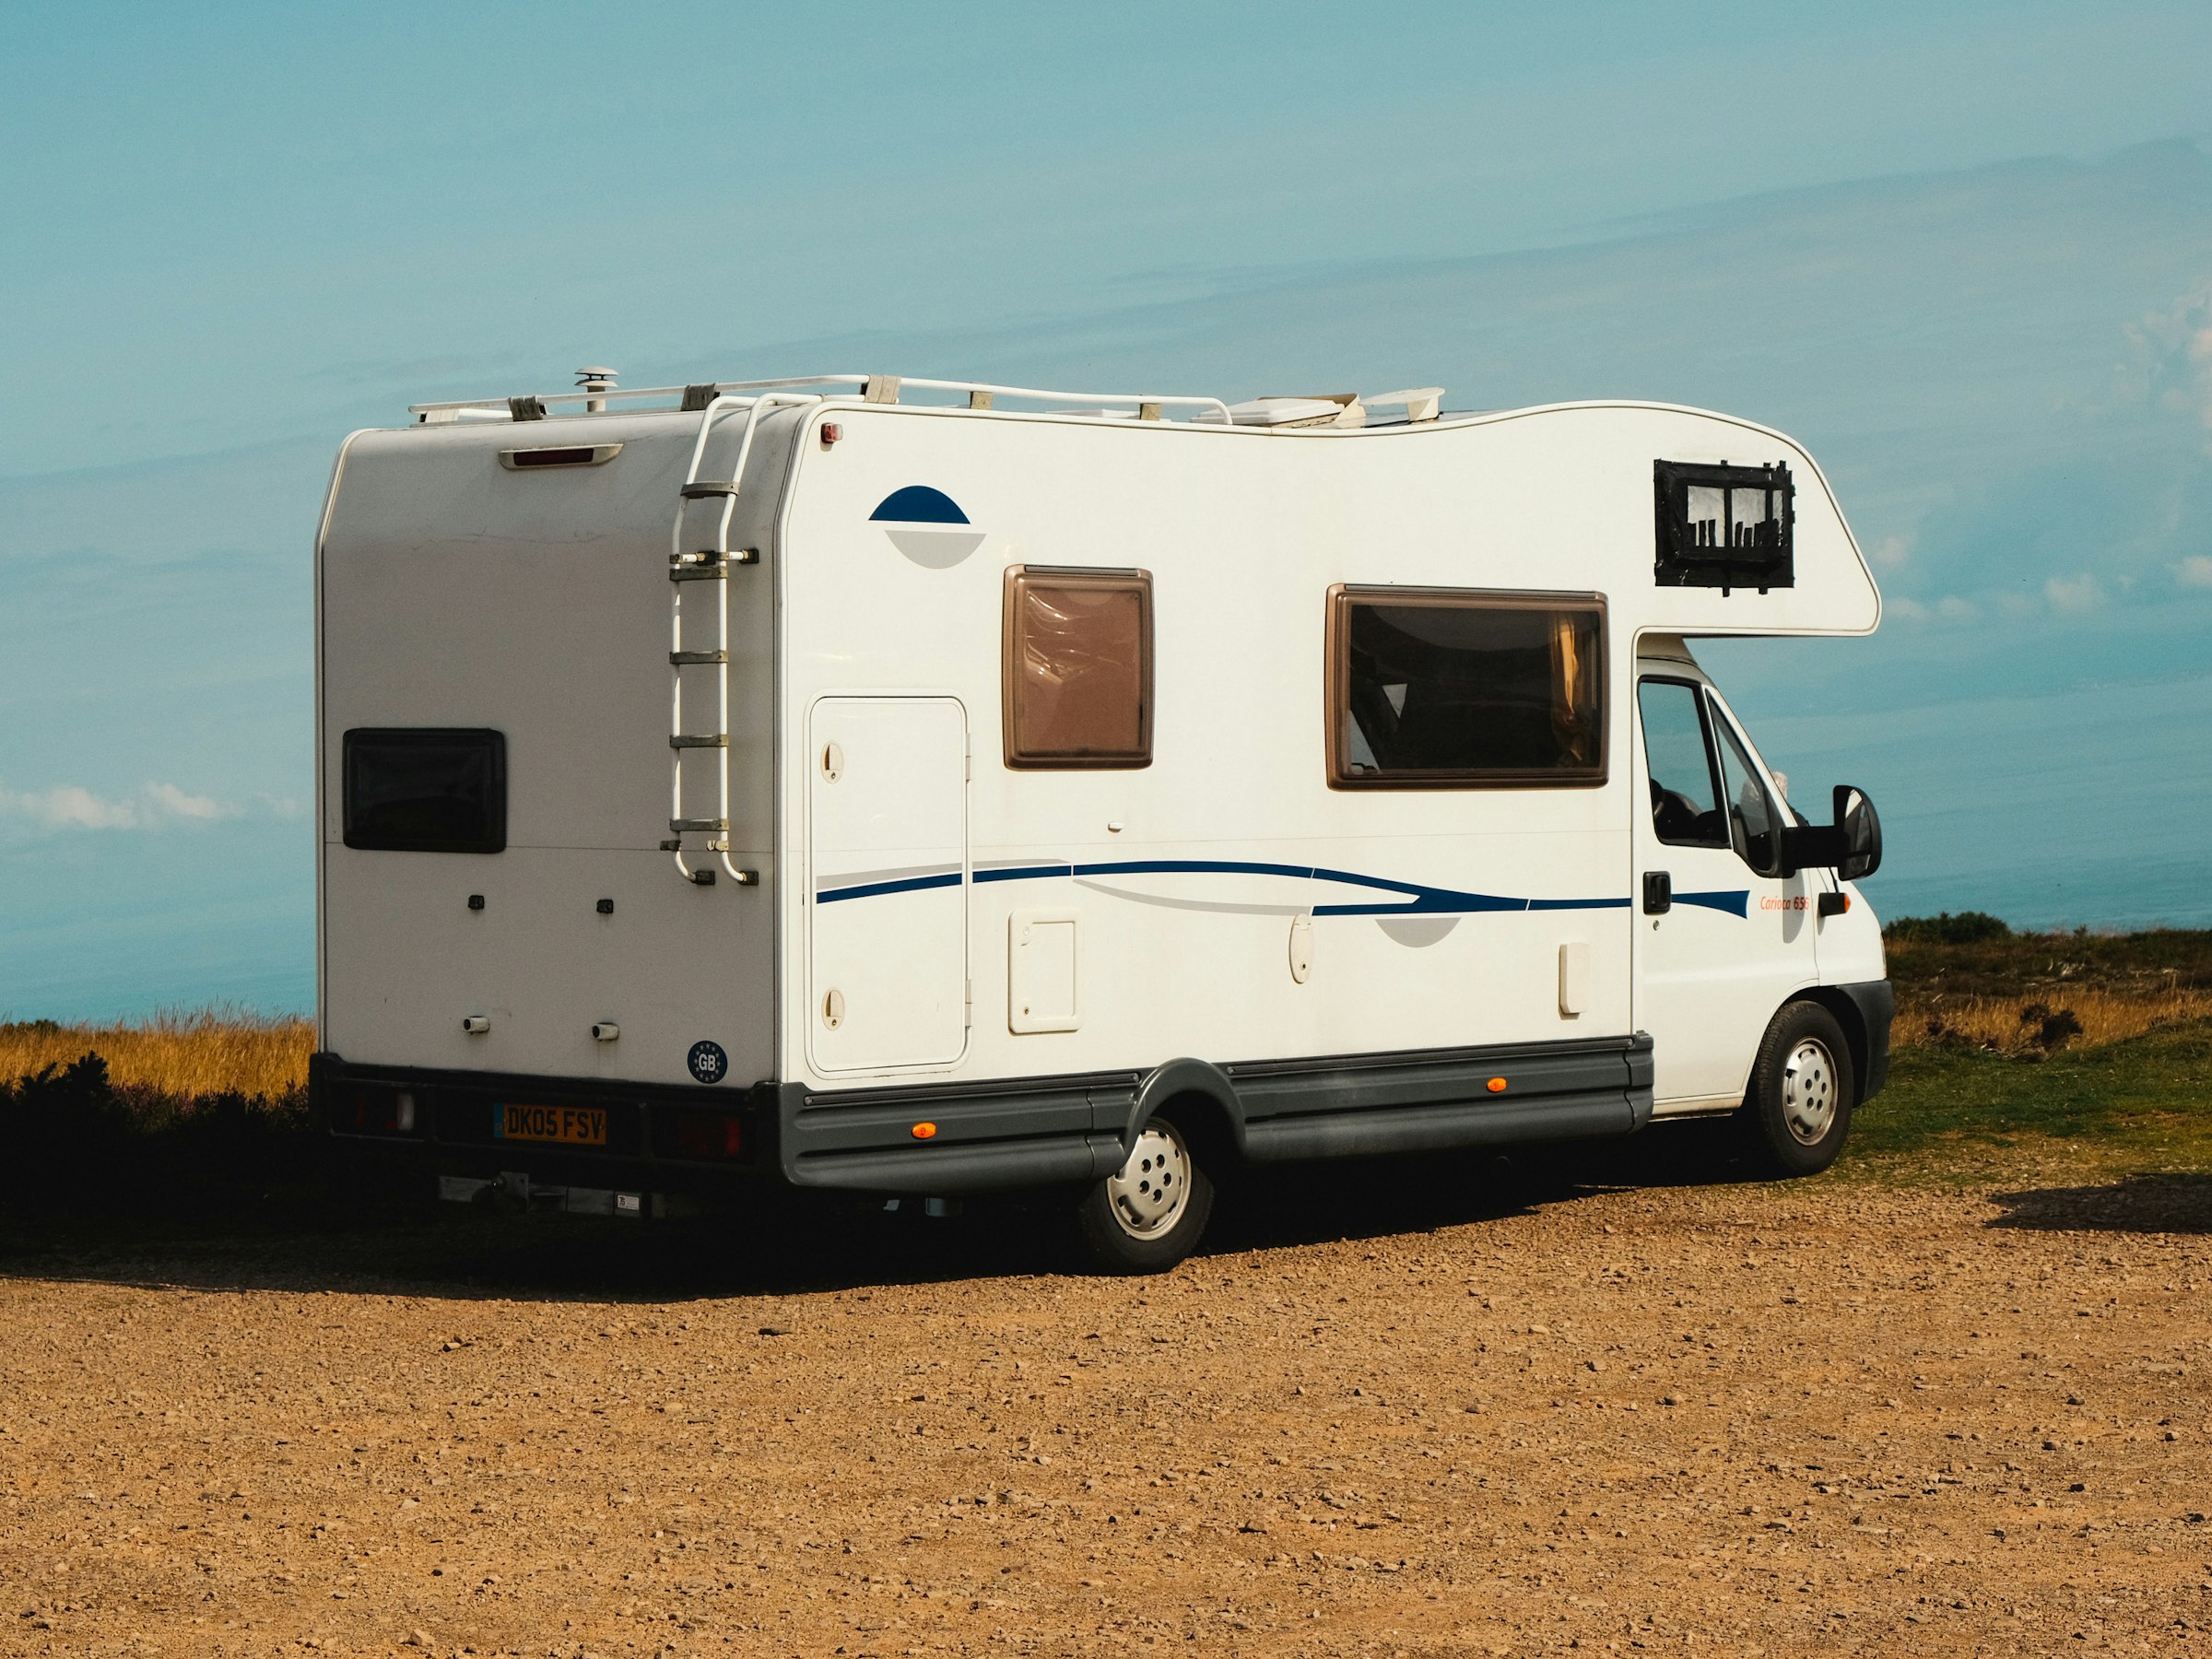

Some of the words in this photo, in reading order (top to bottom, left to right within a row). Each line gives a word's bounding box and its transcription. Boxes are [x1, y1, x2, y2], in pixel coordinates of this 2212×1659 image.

[1759, 895, 1791, 911] Carioca
[1793, 896, 1810, 911] 656
[698, 1053, 716, 1072] GB
[507, 1106, 558, 1136] DK05
[563, 1110, 603, 1140] FSV
